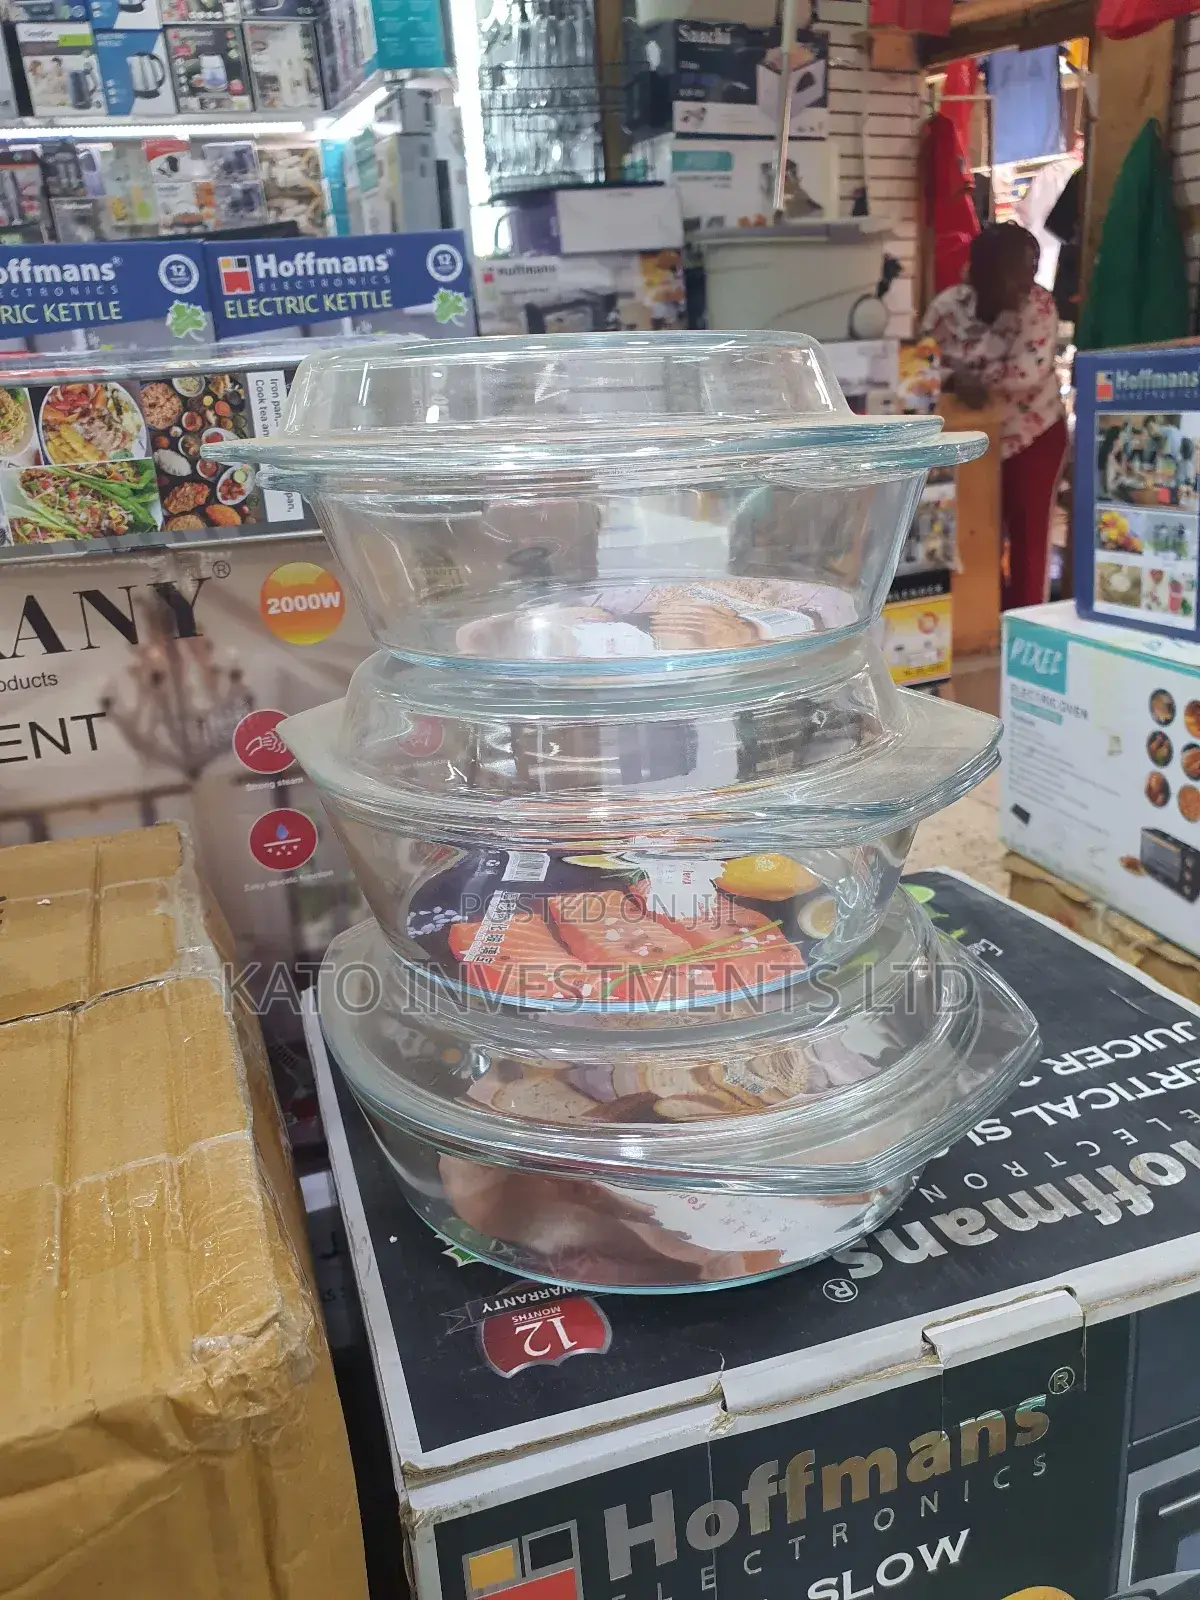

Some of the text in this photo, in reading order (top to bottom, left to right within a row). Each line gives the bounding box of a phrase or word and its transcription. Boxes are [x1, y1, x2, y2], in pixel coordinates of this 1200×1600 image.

[44, 301, 123, 322] KETTLE
[224, 289, 393, 319] ELECTRIC KETTLE
[255, 379, 266, 405] Cook
[270, 378, 280, 399] Iron
[259, 406, 269, 423] tea
[266, 590, 341, 616] 2000W
[1040, 1020, 1197, 1076] JUICER
[512, 1305, 562, 1323] MONTHS
[514, 1315, 578, 1357] 12
[807, 1528, 971, 1600] SLOW
